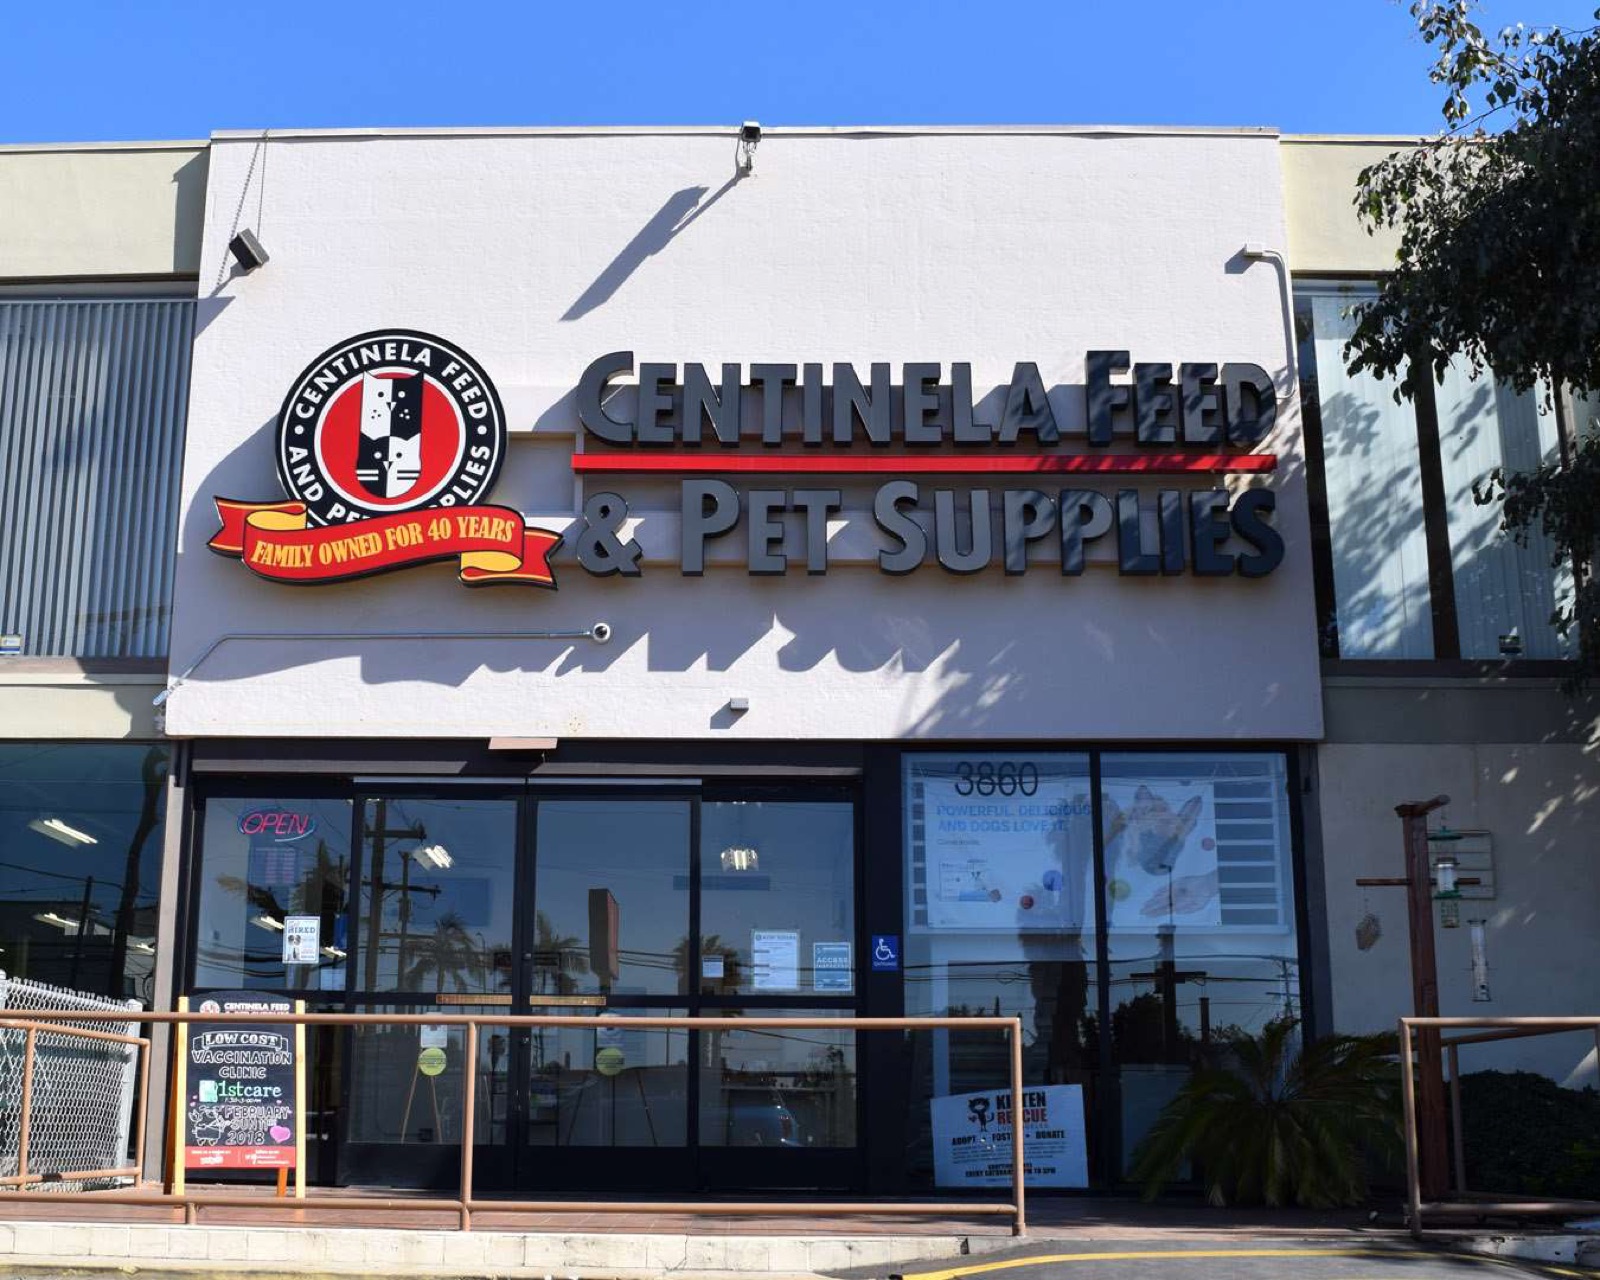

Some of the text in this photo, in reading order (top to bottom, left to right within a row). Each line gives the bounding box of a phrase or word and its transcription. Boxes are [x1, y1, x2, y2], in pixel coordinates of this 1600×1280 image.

[295, 342, 488, 419] CENTINELA FEED
[577, 350, 1277, 448] CENTINELA FEED
[289, 446, 323, 501] AND
[575, 478, 1285, 577] & PET SUPPLIES
[251, 514, 516, 569] FAMILY OWNED FOR 40 YEARS
[954, 761, 1039, 796] 3860
[242, 813, 309, 835] OPEN
[205, 1033, 279, 1046] LOW COST
[191, 1049, 292, 1065] VACCINATION
[218, 1066, 267, 1080] CLINIC
[996, 1091, 1046, 1110] KITEN
[224, 1105, 290, 1120] FEBRUARY
[997, 1107, 1048, 1125] RECUE
[224, 1130, 265, 1146] 2018
[992, 1132, 1013, 1142] FOST
